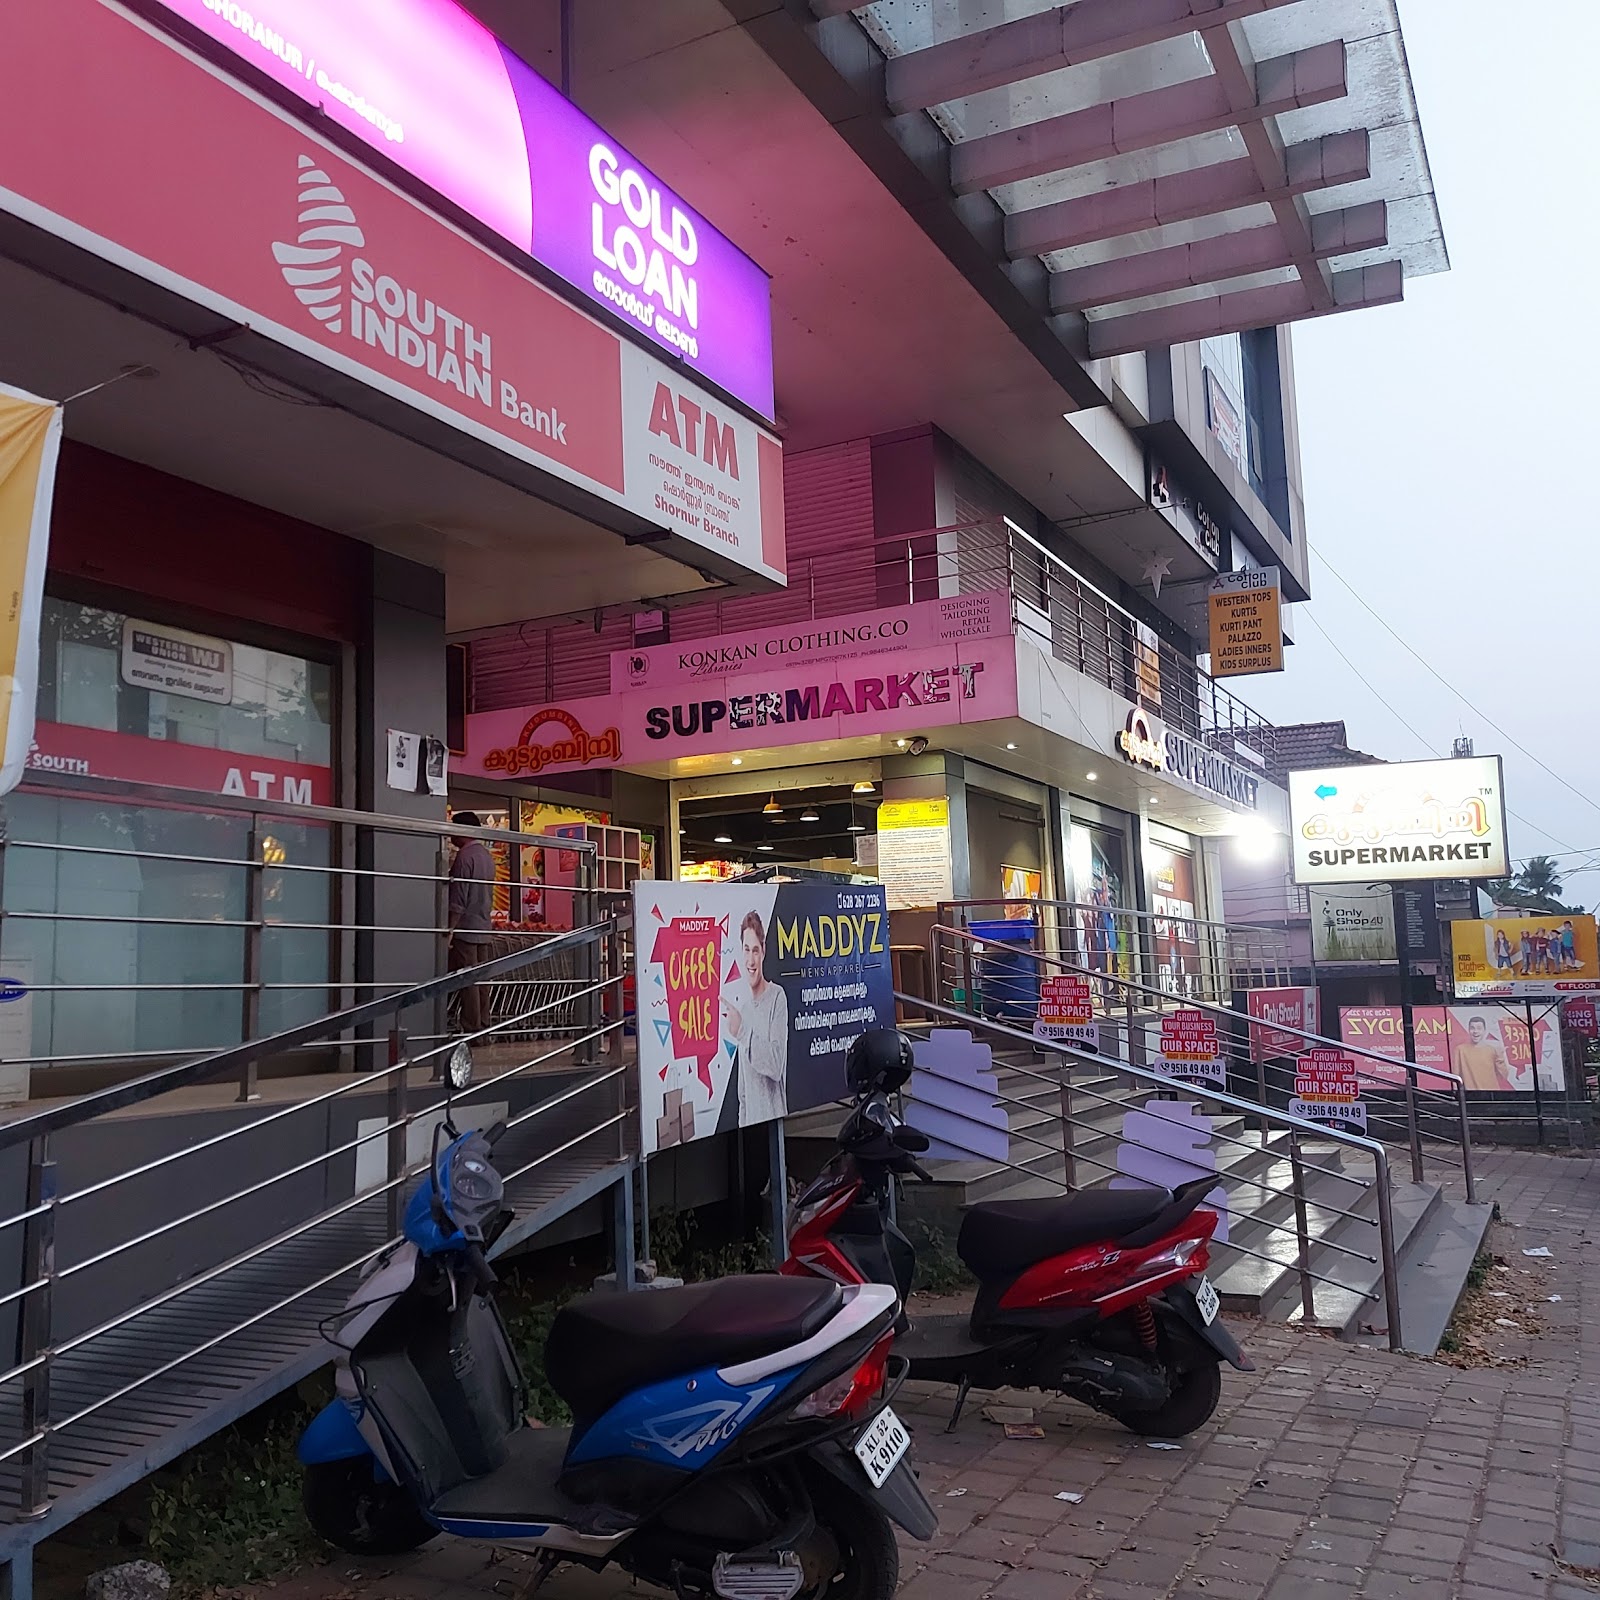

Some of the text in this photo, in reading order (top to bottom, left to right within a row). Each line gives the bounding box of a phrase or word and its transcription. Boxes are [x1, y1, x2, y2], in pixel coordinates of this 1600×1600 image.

[588, 143, 699, 266] GOLD
[591, 202, 699, 330] LOAN
[351, 257, 492, 372] SOUTH
[351, 299, 568, 446] INDIAN Bank
[648, 380, 740, 482] ATM
[654, 493, 740, 547] Shornur Branch
[1227, 572, 1267, 583] Cotton
[940, 597, 990, 612] DESIGNING
[1215, 591, 1272, 607] WESTERN TOPS
[942, 606, 990, 621] TAILORING
[1231, 606, 1257, 618] KURTIS
[962, 615, 991, 627] RETAIL
[1220, 618, 1262, 632] KURTI PANT
[940, 625, 991, 639] WHOLESALE
[1227, 631, 1262, 643] PALAZZO
[134, 632, 187, 653] WESTERN
[678, 619, 909, 670] KONKAN CLOTHING.CO
[151, 645, 221, 669] UNION WU
[1217, 643, 1272, 657] LADIES INNERS
[1220, 656, 1272, 670] KIDS SURPLUS
[644, 661, 984, 740] SUPERMARKET
[524, 711, 578, 738] KUDUMBINI
[484, 727, 622, 775] കുടുംബിനി
[32, 753, 89, 773] SOUTH
[221, 768, 312, 805] ATM
[1307, 842, 1492, 867] SUPERMARKET
[843, 894, 853, 909] 628
[854, 894, 865, 909] 267
[1336, 908, 1362, 918] Only
[679, 921, 710, 932] MADDYZ
[1336, 917, 1369, 926] Shop
[776, 913, 884, 960] MADDYZ
[669, 941, 720, 991] OFFER
[1458, 962, 1485, 972] Clothes
[1055, 979, 1076, 987] GROW
[1043, 987, 1088, 996] YOUR BUSINESS
[1056, 996, 1074, 1004] WITH
[1041, 1005, 1090, 1017] OUR SPACE
[1177, 1012, 1199, 1021] GROW
[679, 995, 715, 1044] SALE
[1164, 1021, 1213, 1031] YOUR BUSINESS
[1048, 1027, 1095, 1039] 9516 49 49 49
[1179, 1031, 1198, 1039] WITH
[1162, 1040, 1217, 1053] OUR SPACE
[1314, 1052, 1338, 1061] GROW
[1170, 1062, 1221, 1076] 9516 49 49 49
[1300, 1061, 1352, 1072] YOUR BUSINESS
[1316, 1071, 1337, 1080] WITH
[1297, 1081, 1320, 1093] OUR
[1321, 1082, 1356, 1095] SPACE
[1307, 1104, 1361, 1118] 9516 49 49 49
[1100, 1250, 1122, 1268] Z
[864, 1419, 889, 1454] KL 52
[869, 1427, 904, 1479] K 9110
